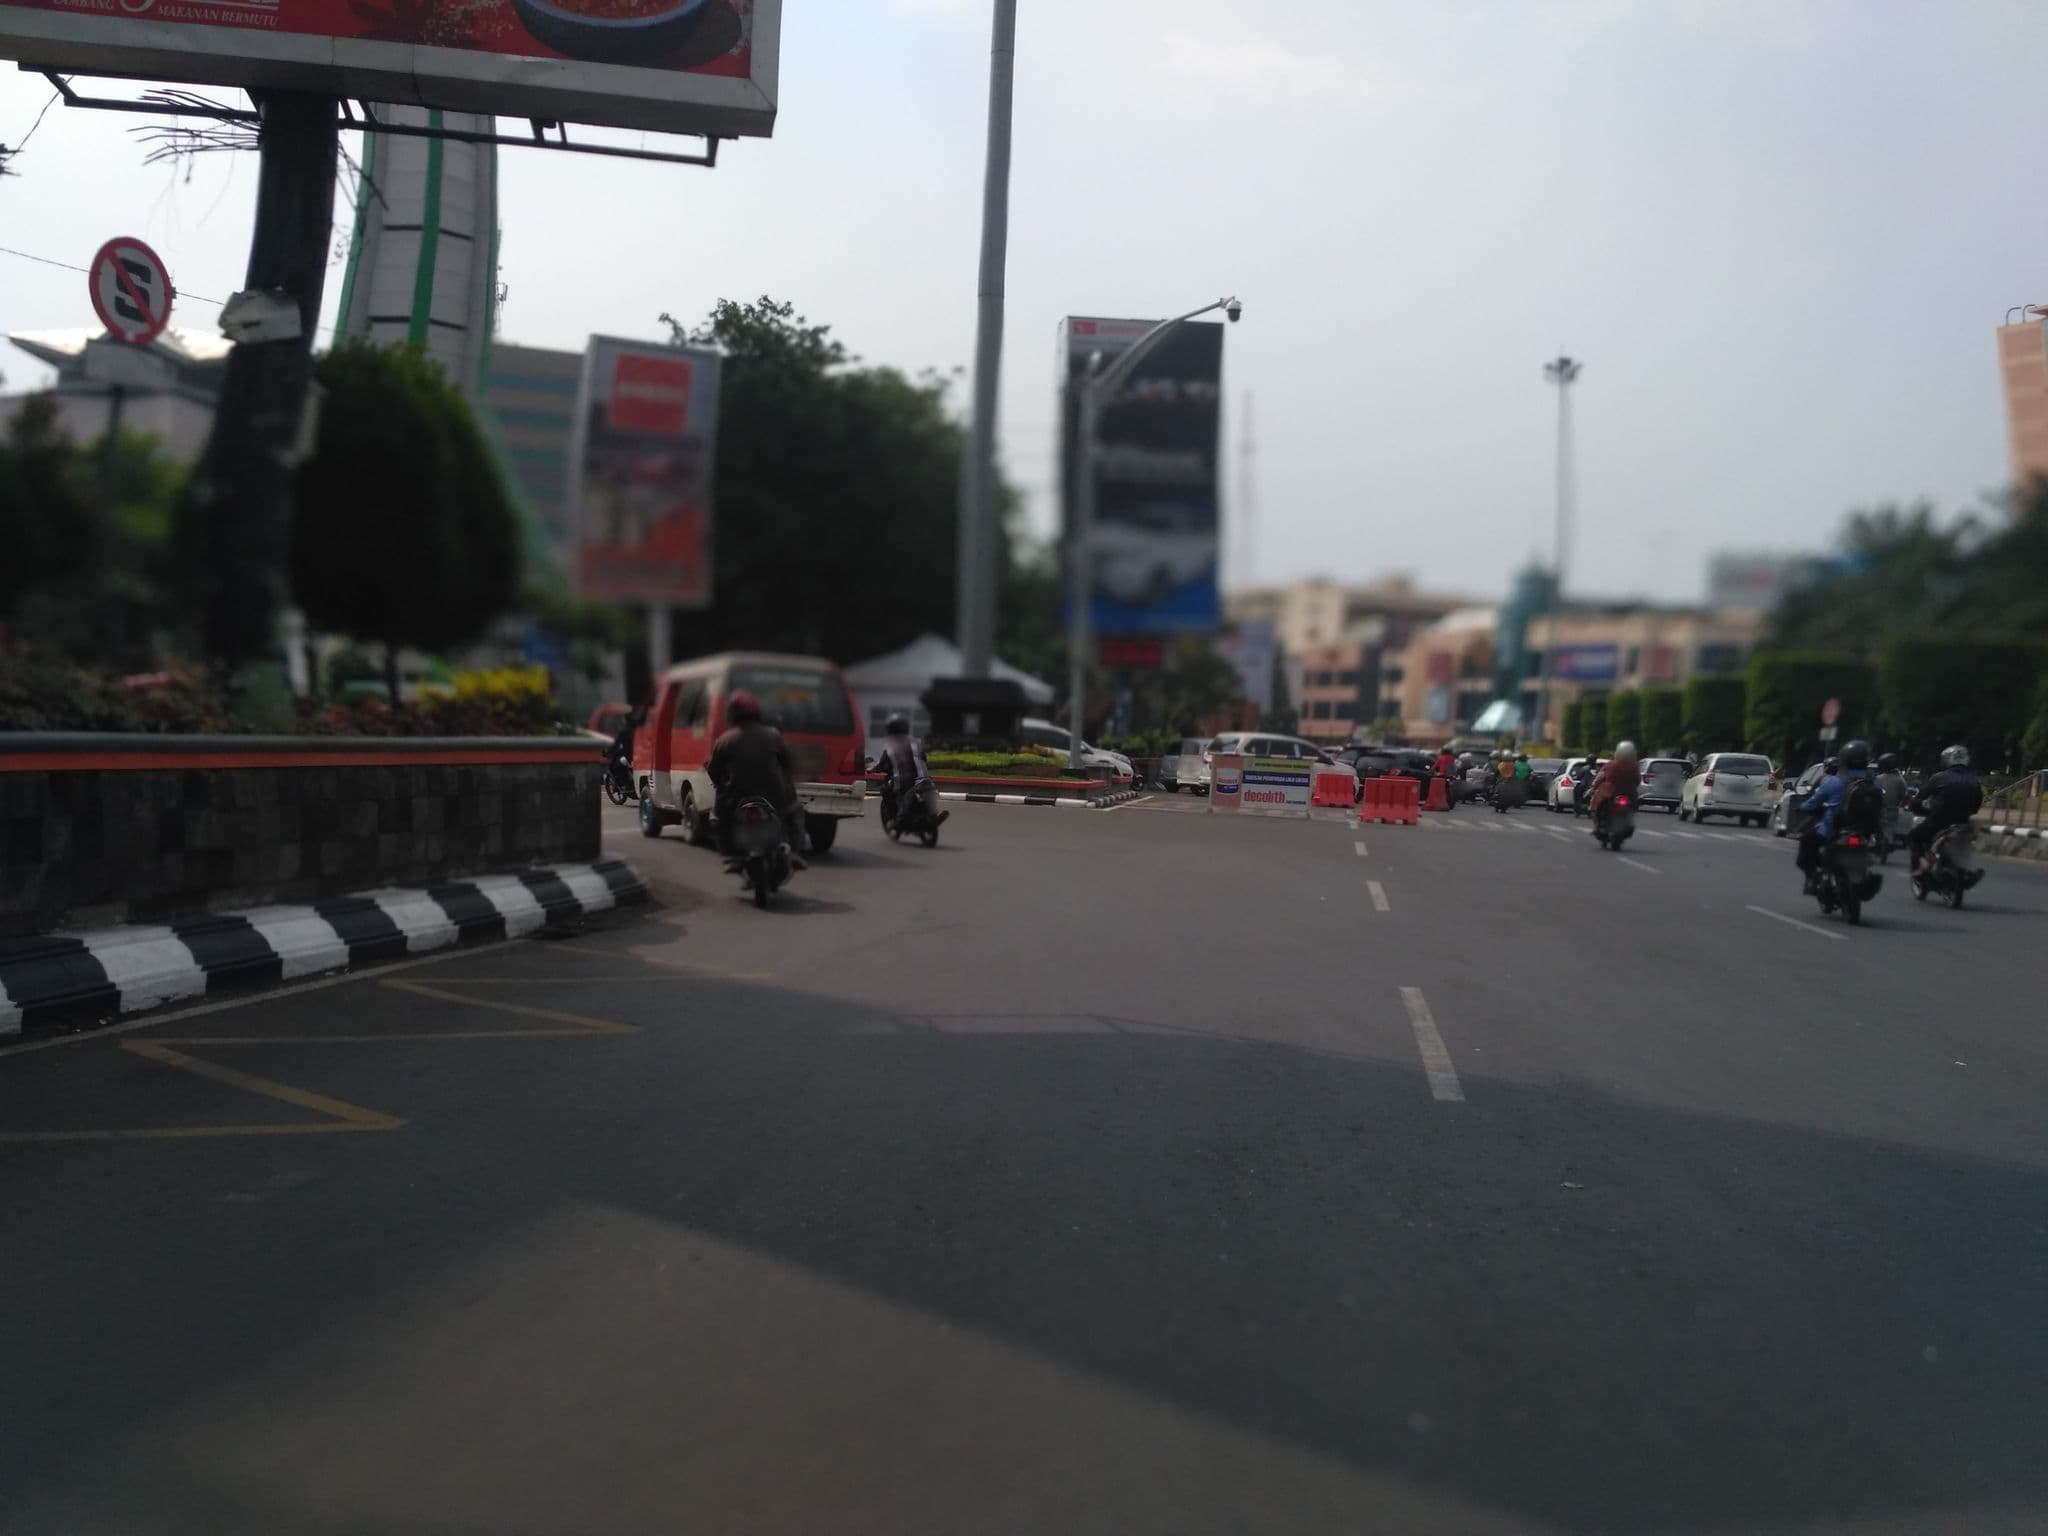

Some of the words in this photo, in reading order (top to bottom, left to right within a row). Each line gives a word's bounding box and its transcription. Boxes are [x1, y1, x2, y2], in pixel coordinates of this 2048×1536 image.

[158, 4, 218, 20] MAKANAN
[221, 10, 280, 27] BERMUTU
[1244, 790, 1286, 804] decolith
